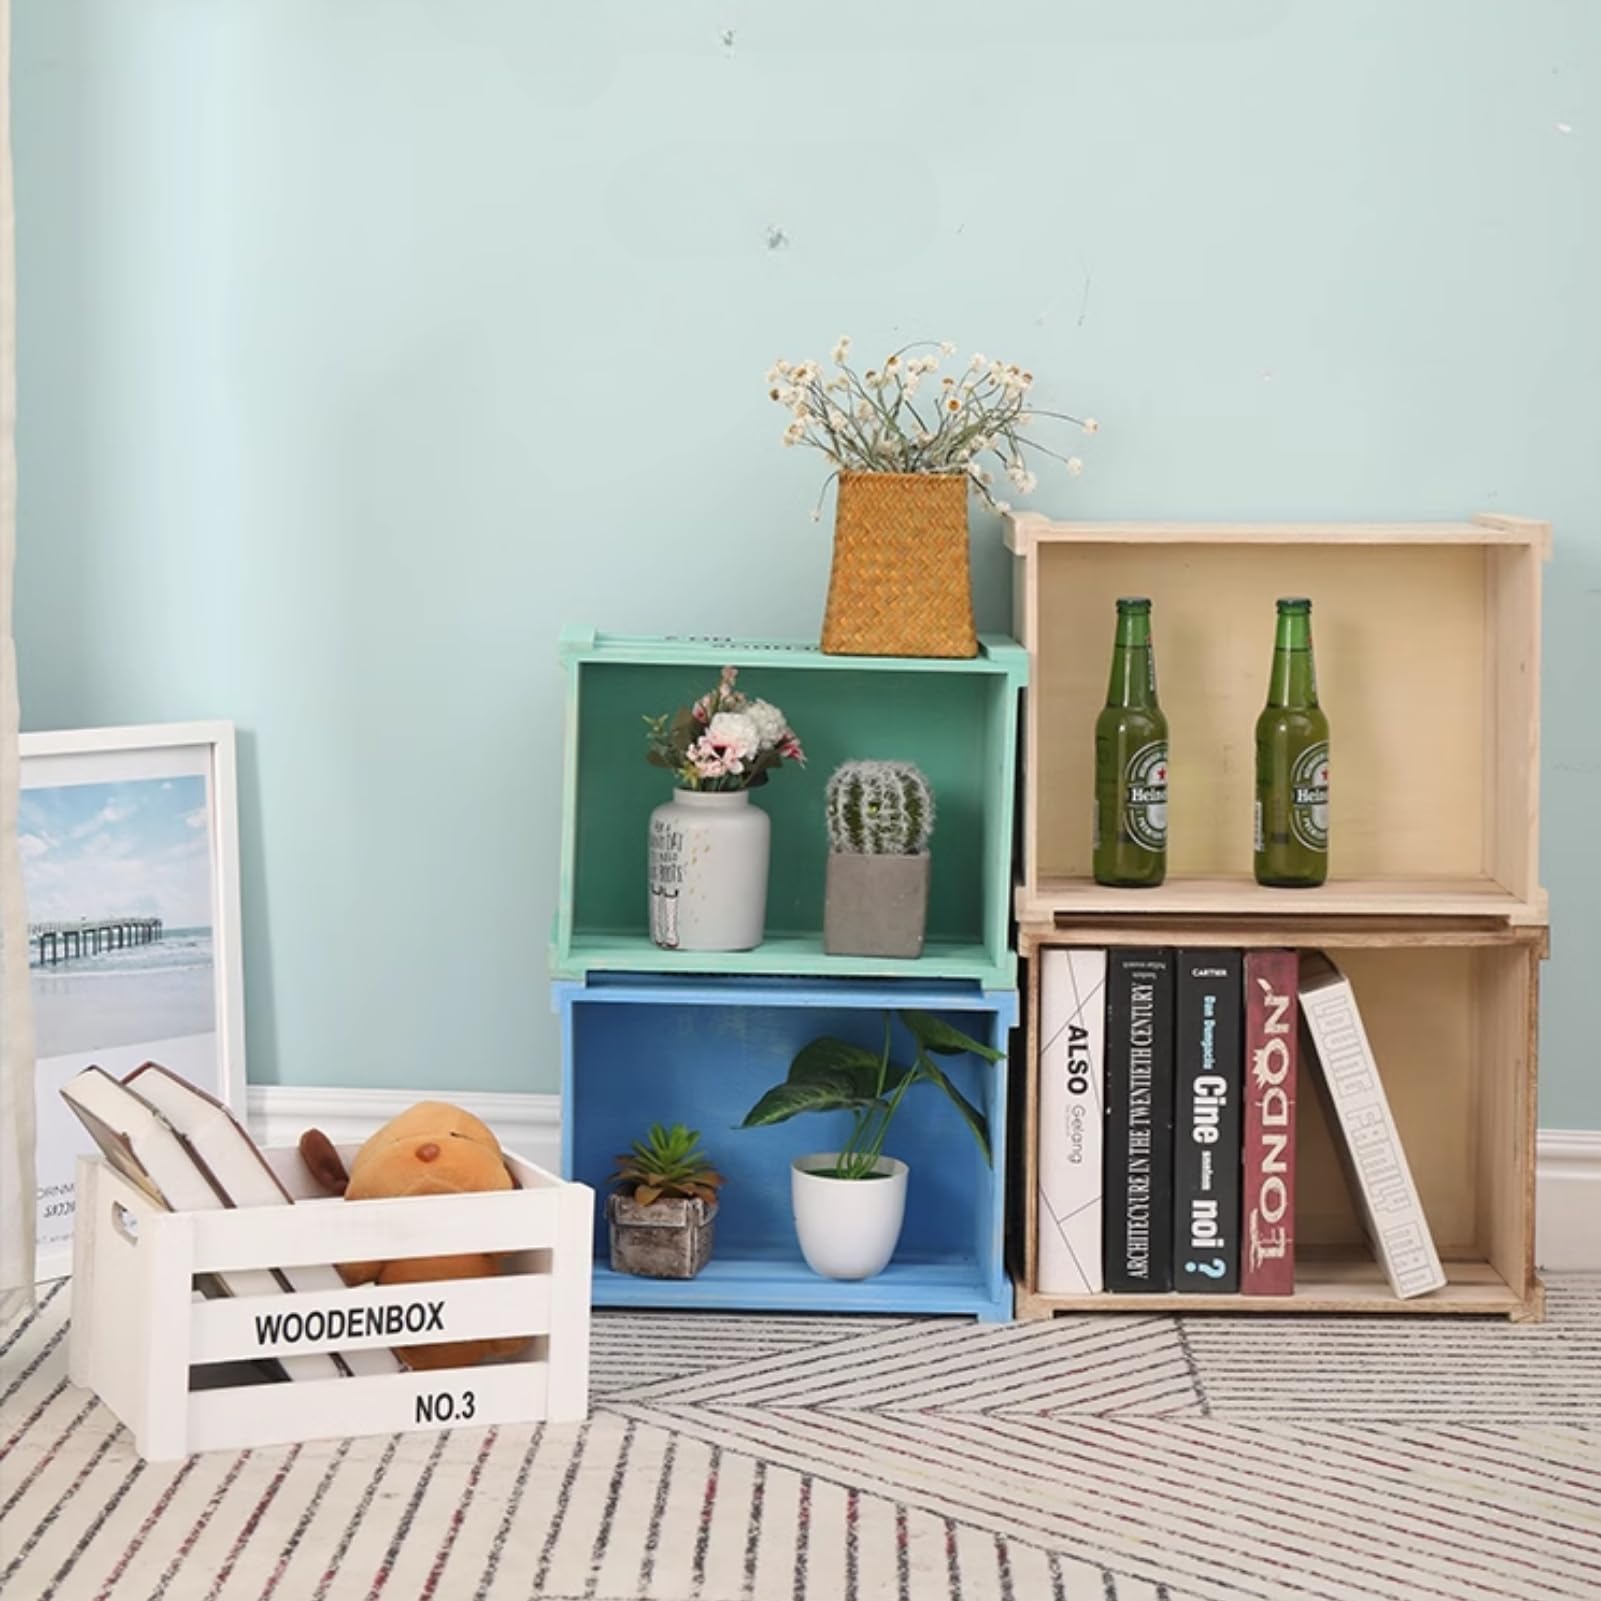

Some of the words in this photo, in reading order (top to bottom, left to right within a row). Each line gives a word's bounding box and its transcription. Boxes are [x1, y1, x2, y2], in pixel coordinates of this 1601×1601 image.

[1192, 967, 1228, 979] CARTIER
[1130, 982, 1154, 1047] CENTURY
[1067, 1024, 1089, 1095] ALSO
[1129, 1047, 1152, 1126] TWENTIETH
[1192, 1074, 1228, 1144] Cine
[1129, 1128, 1151, 1155] THE
[1250, 978, 1292, 1272] LONDON
[1128, 1157, 1150, 1175] IN
[1191, 1199, 1226, 1249] noi
[254, 1300, 446, 1346] WOODENBOX
[414, 1390, 476, 1423] NO.3
